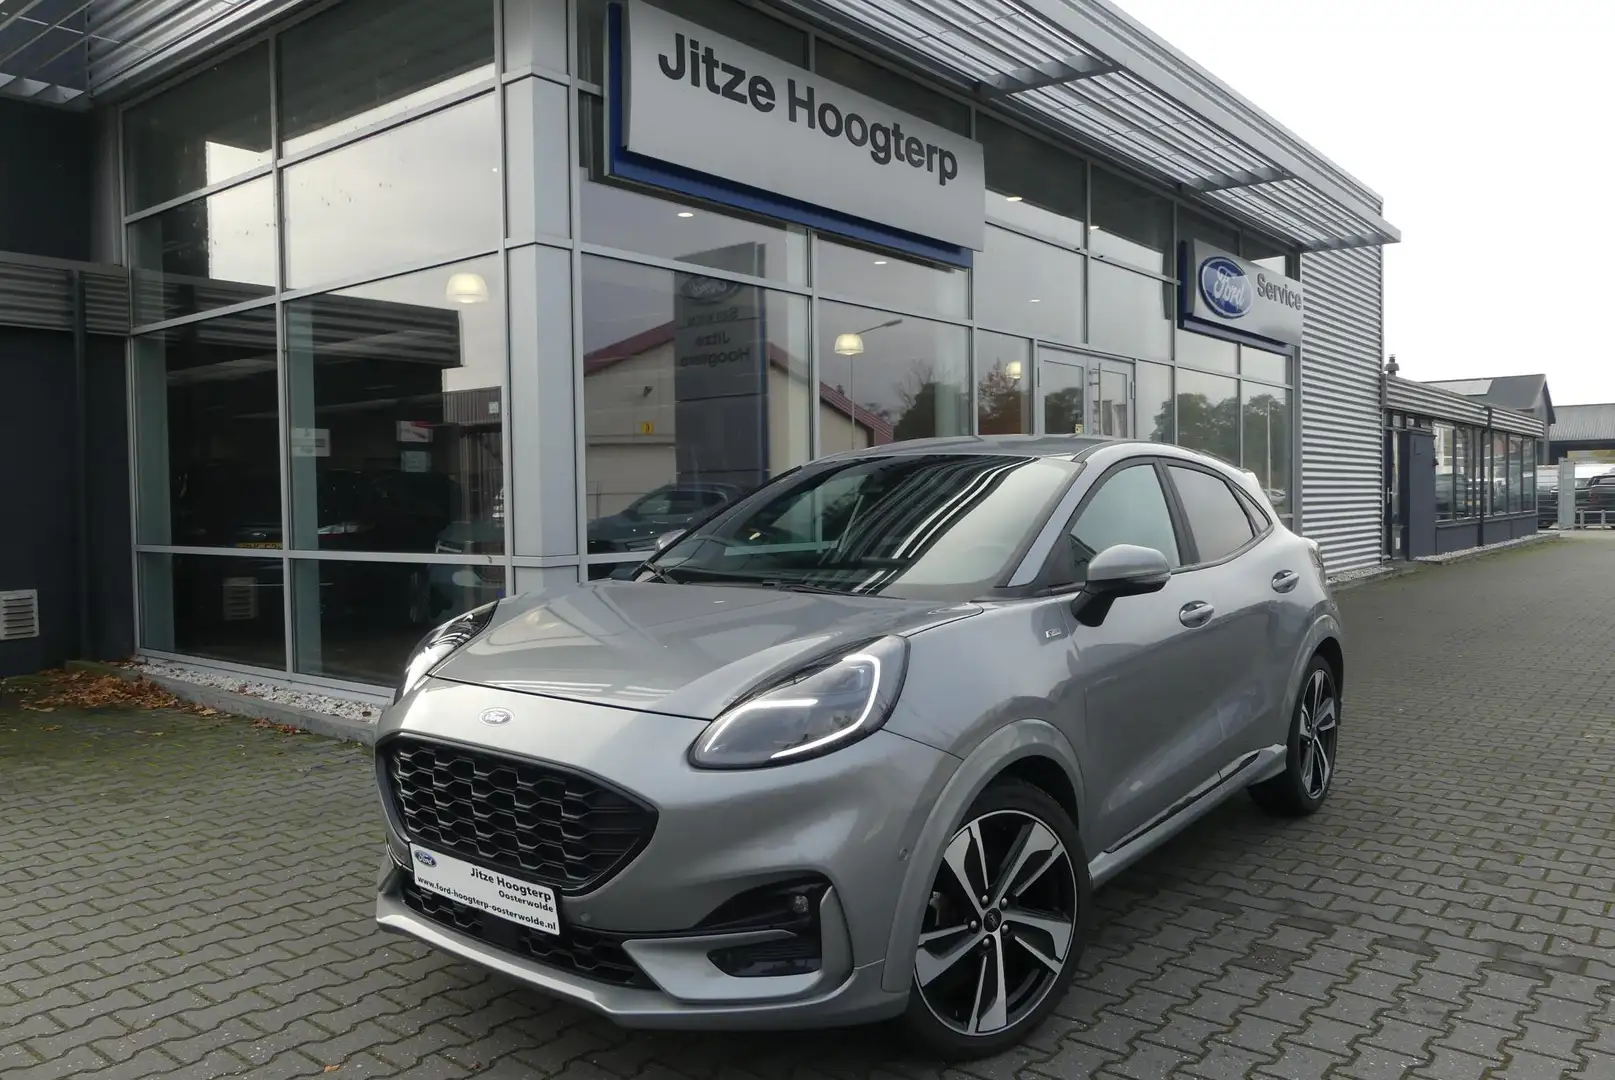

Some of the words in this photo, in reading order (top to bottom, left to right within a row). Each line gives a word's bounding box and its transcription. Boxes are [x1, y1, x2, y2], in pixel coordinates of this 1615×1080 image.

[658, 33, 775, 113] Jitze
[788, 78, 959, 186] Hoogterp
[1213, 266, 1246, 311] Ford
[1257, 273, 1301, 311] Service
[417, 852, 434, 865] Ford
[417, 876, 556, 930] www.ford-hoogterp-oosterwolde.nl
[470, 867, 494, 884] Jitze
[497, 876, 552, 902] Hoogterp
[499, 890, 554, 913] Oosterwolde
